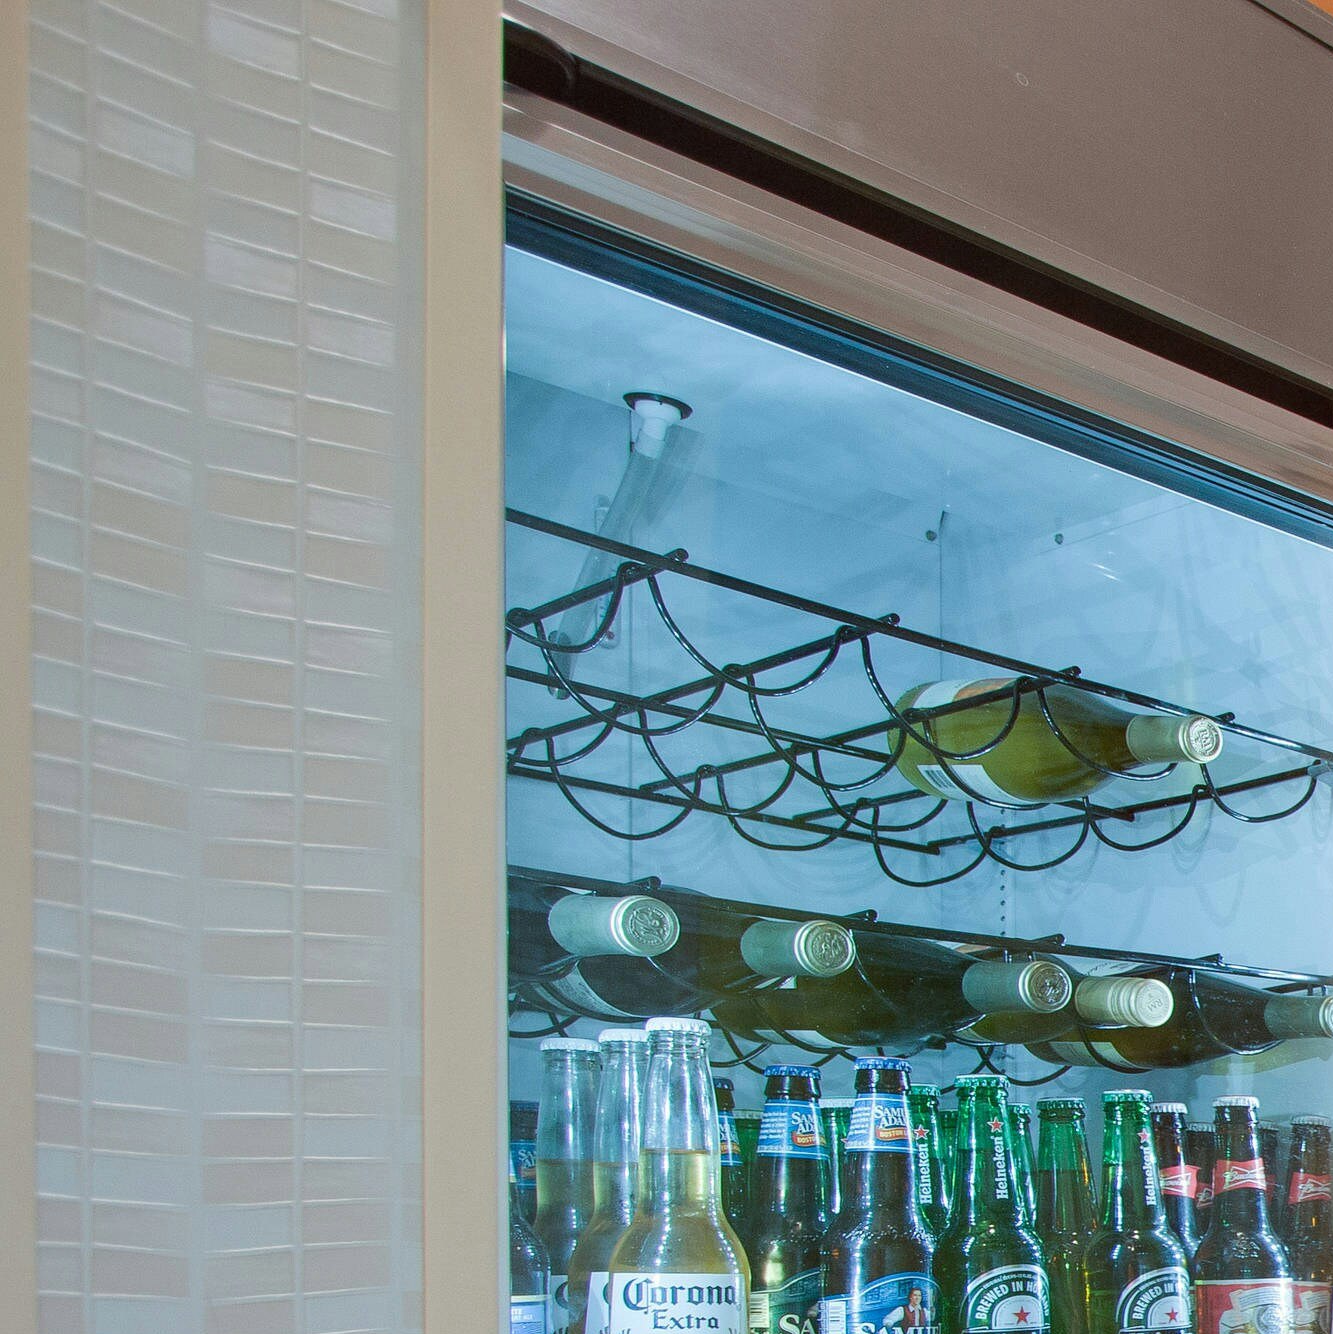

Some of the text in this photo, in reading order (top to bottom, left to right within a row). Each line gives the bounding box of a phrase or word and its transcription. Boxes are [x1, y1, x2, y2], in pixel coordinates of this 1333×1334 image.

[874, 1105, 906, 1119] SAMU
[919, 1143, 933, 1205] Heineken
[990, 1135, 1009, 1200] Heineken
[1140, 1144, 1157, 1206] Heineken
[623, 1278, 738, 1314] Corona
[975, 1284, 1010, 1321] BREWED
[1011, 1280, 1025, 1293] IN
[651, 1309, 720, 1330] Extra
